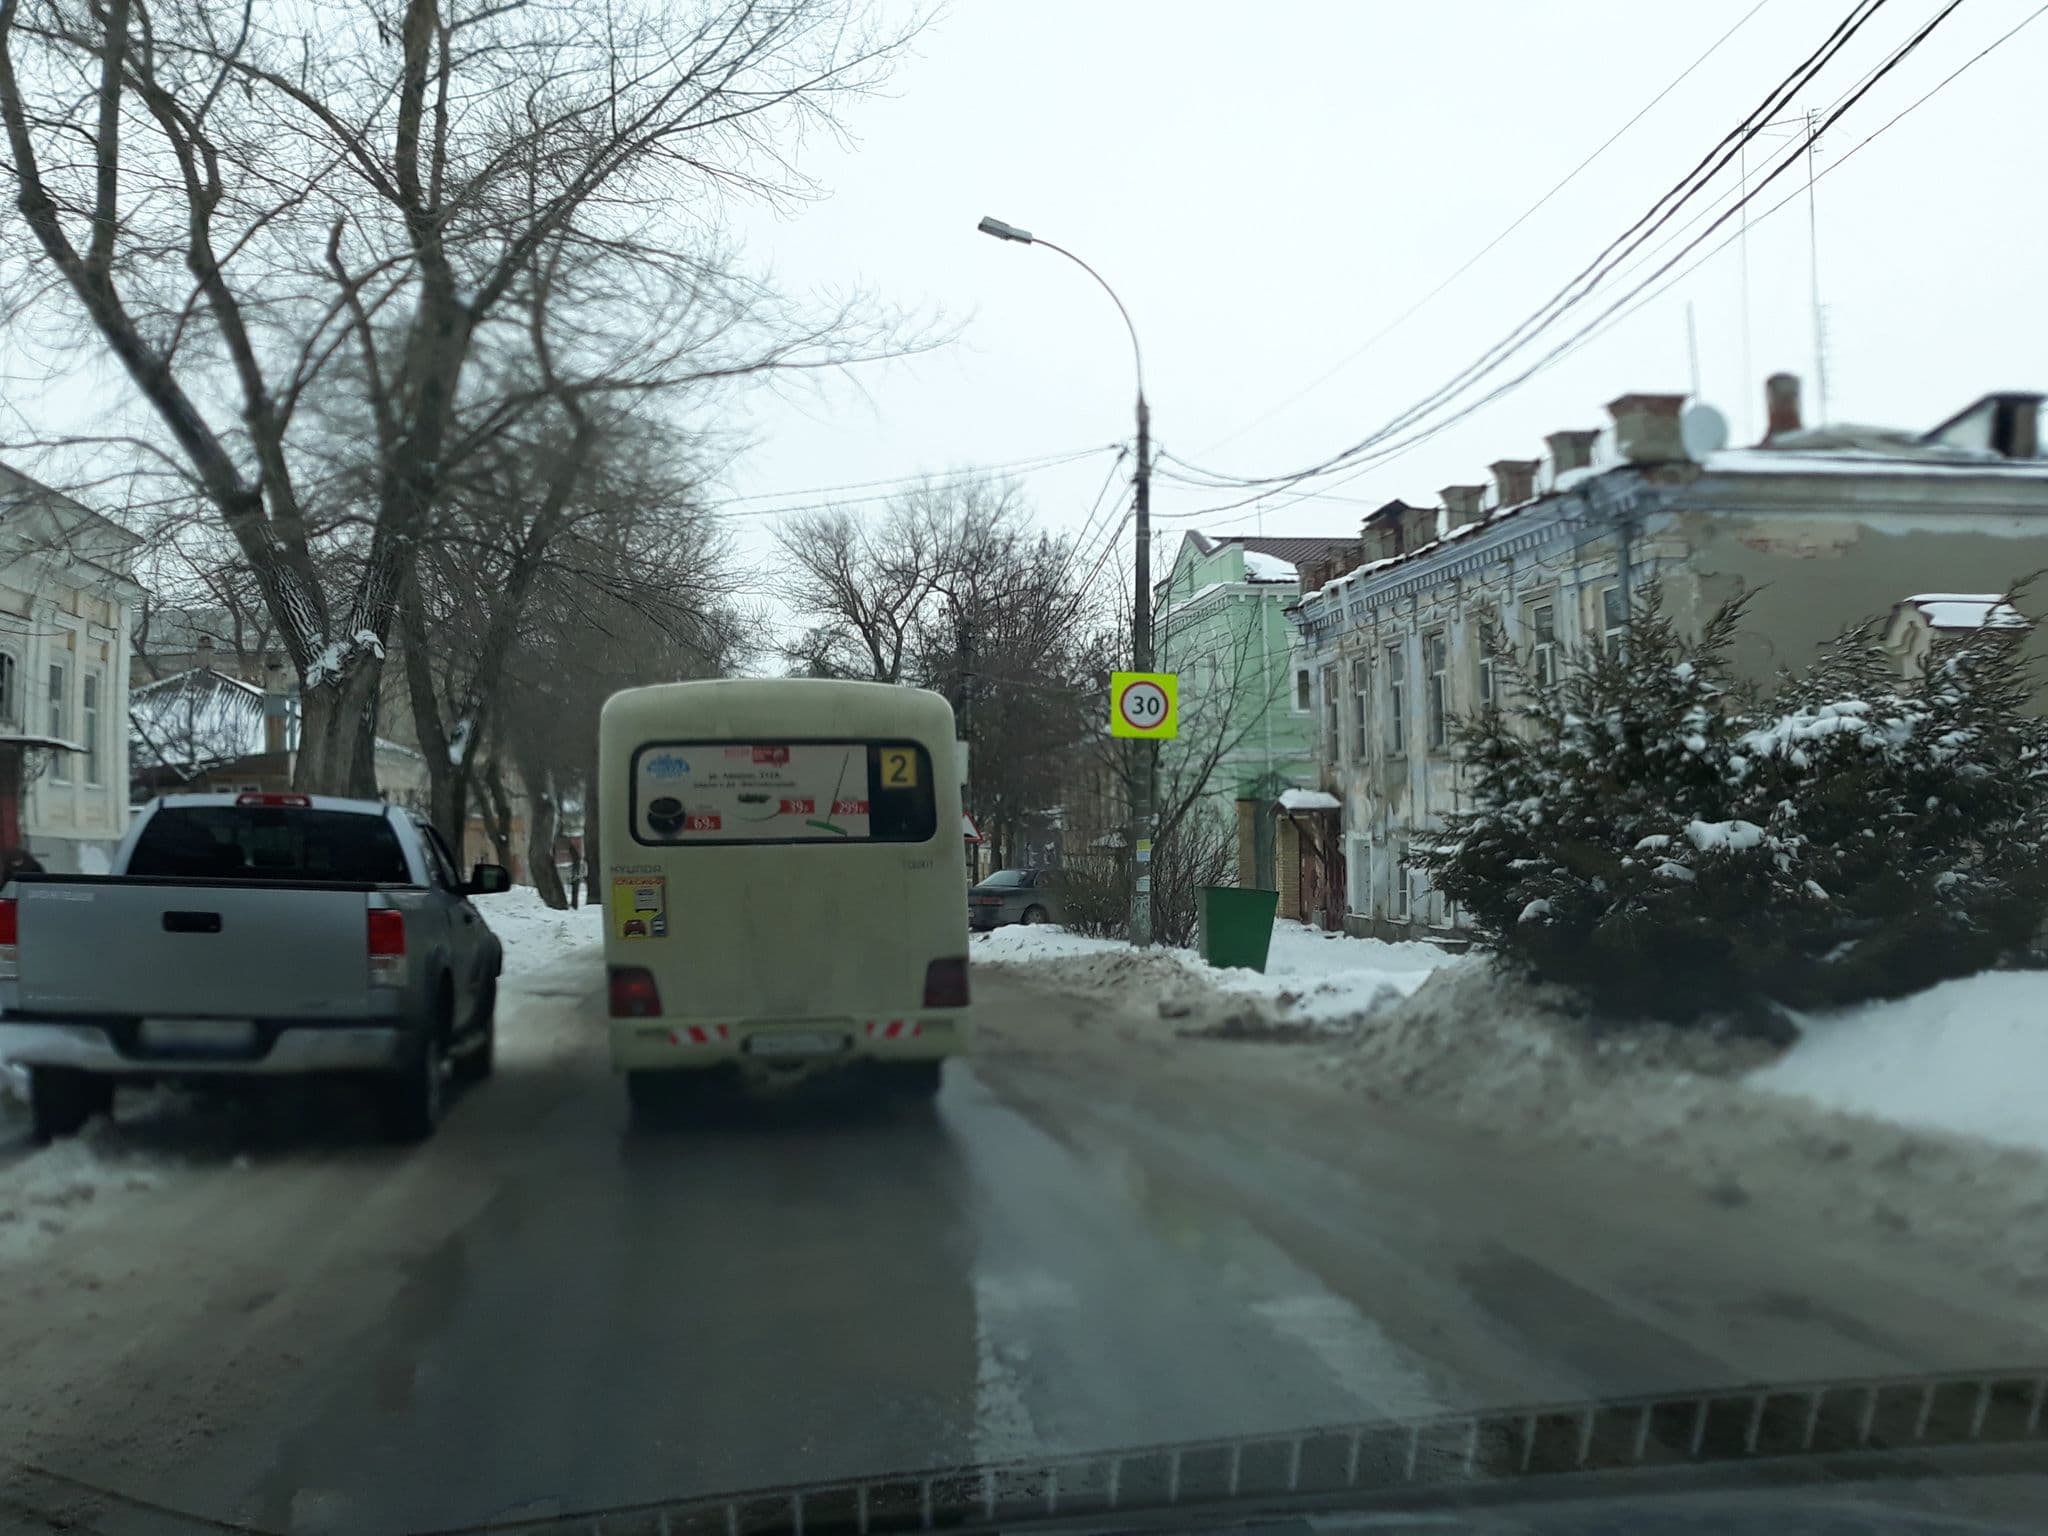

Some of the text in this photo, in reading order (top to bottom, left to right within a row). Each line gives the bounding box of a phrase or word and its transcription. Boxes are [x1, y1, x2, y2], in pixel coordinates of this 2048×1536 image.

[1132, 696, 1160, 716] 30
[889, 755, 908, 783] 2
[610, 864, 663, 873] HYUNDA
